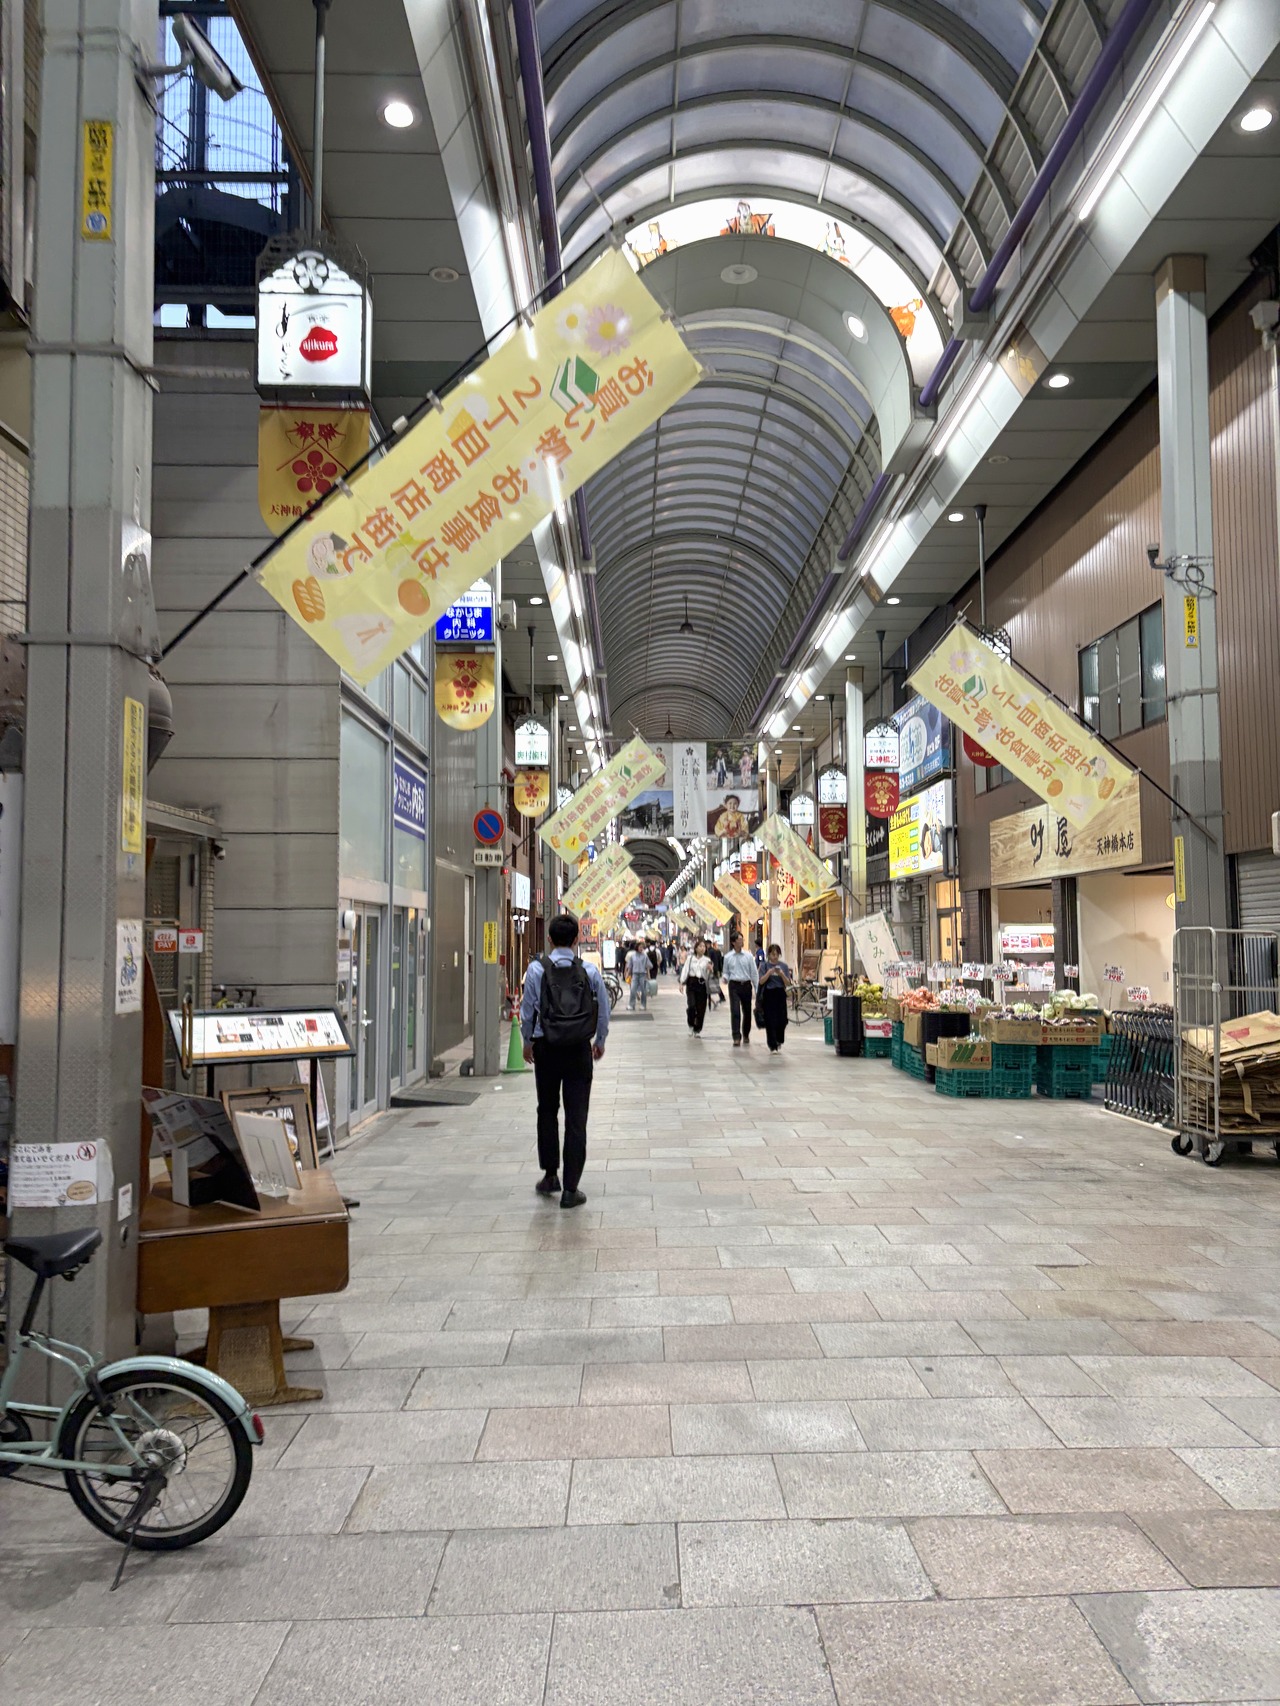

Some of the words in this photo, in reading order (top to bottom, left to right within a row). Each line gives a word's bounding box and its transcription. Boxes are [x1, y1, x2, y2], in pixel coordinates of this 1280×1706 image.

[303, 339, 335, 351] ajikura
[411, 356, 655, 579] お買い物・お食事は
[341, 375, 543, 573] 2丁目商店街で
[452, 618, 477, 629] 内科
[443, 628, 485, 640] クリニック
[868, 754, 897, 764] 天神橋2
[412, 782, 425, 824] 内科
[1096, 830, 1134, 857] 天神橋本店
[475, 852, 502, 863] 自動車
[157, 940, 174, 949] PAY
